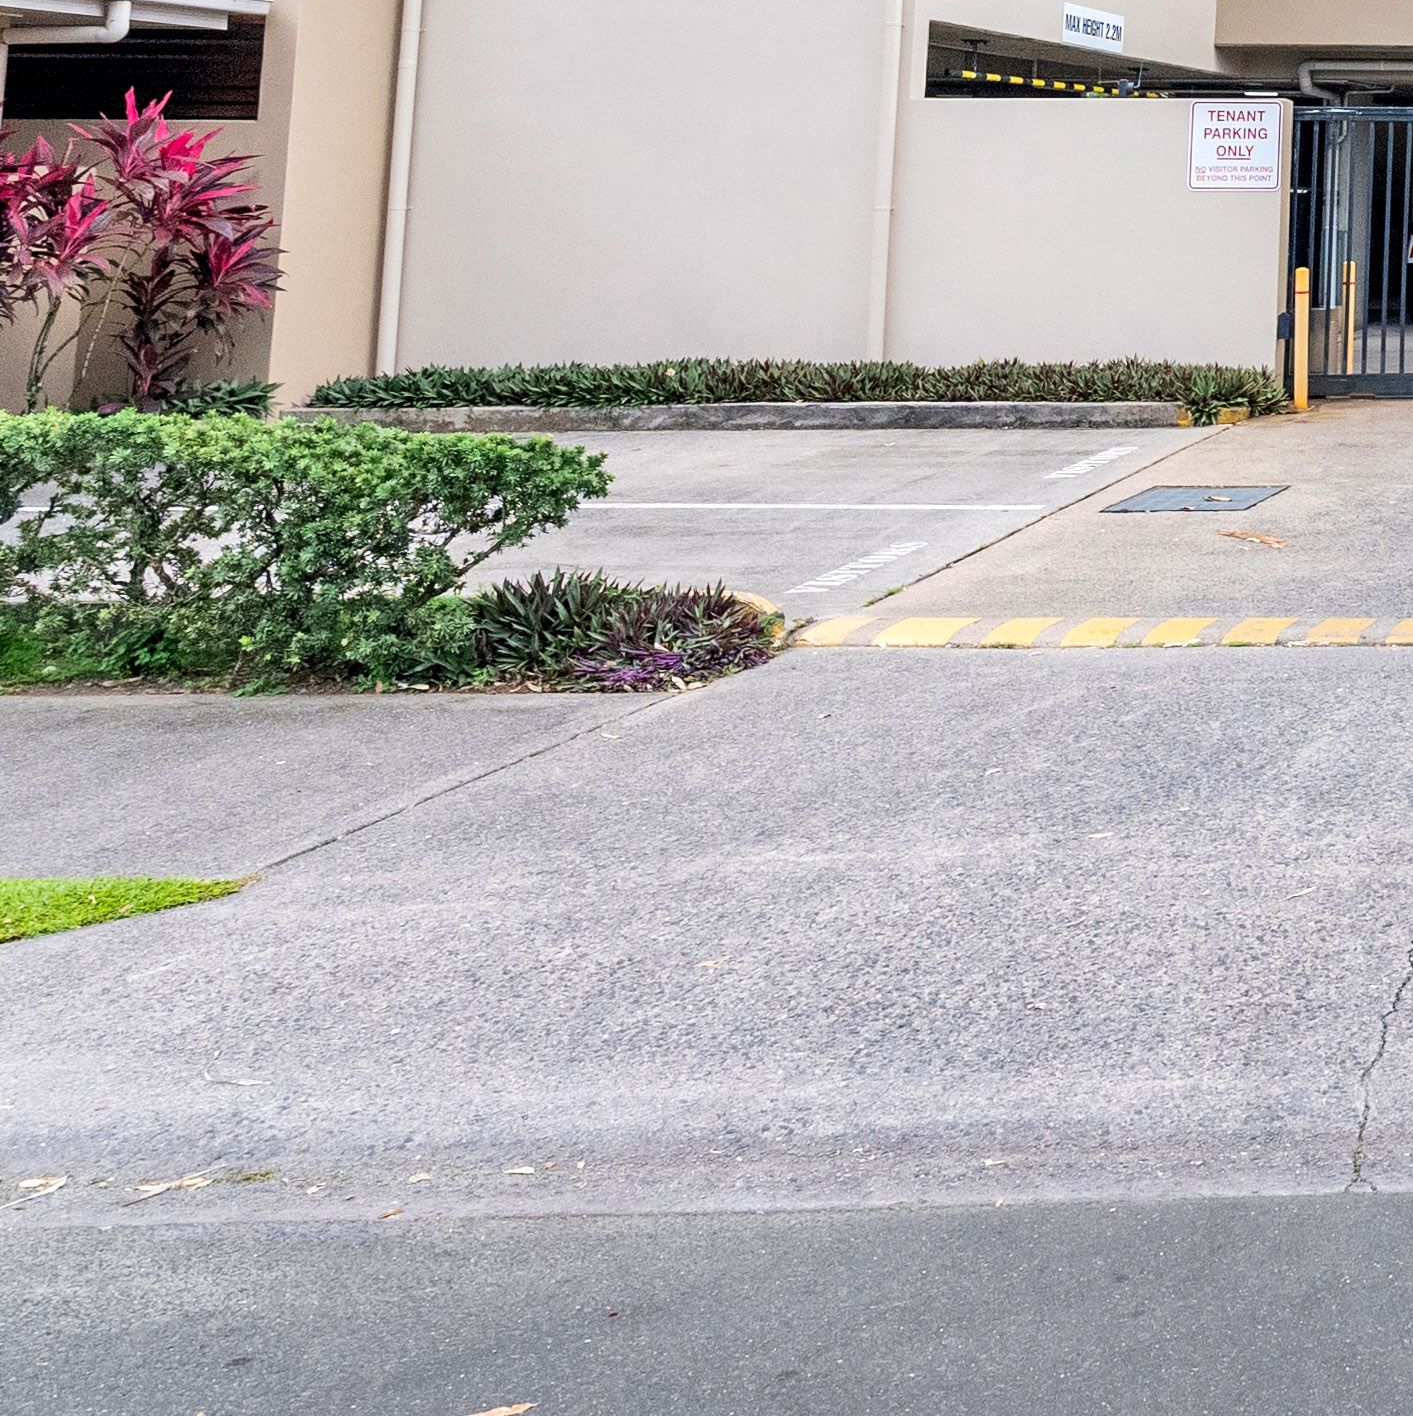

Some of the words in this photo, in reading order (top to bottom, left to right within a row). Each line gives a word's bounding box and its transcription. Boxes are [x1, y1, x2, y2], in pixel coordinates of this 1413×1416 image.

[1065, 13, 1081, 33] MAX
[1082, 17, 1104, 38] HEIGHT
[1105, 22, 1122, 42] 2.2M
[1207, 110, 1266, 122] TENANT
[1203, 127, 1268, 139] PARKING
[1216, 145, 1254, 157] ONLY
